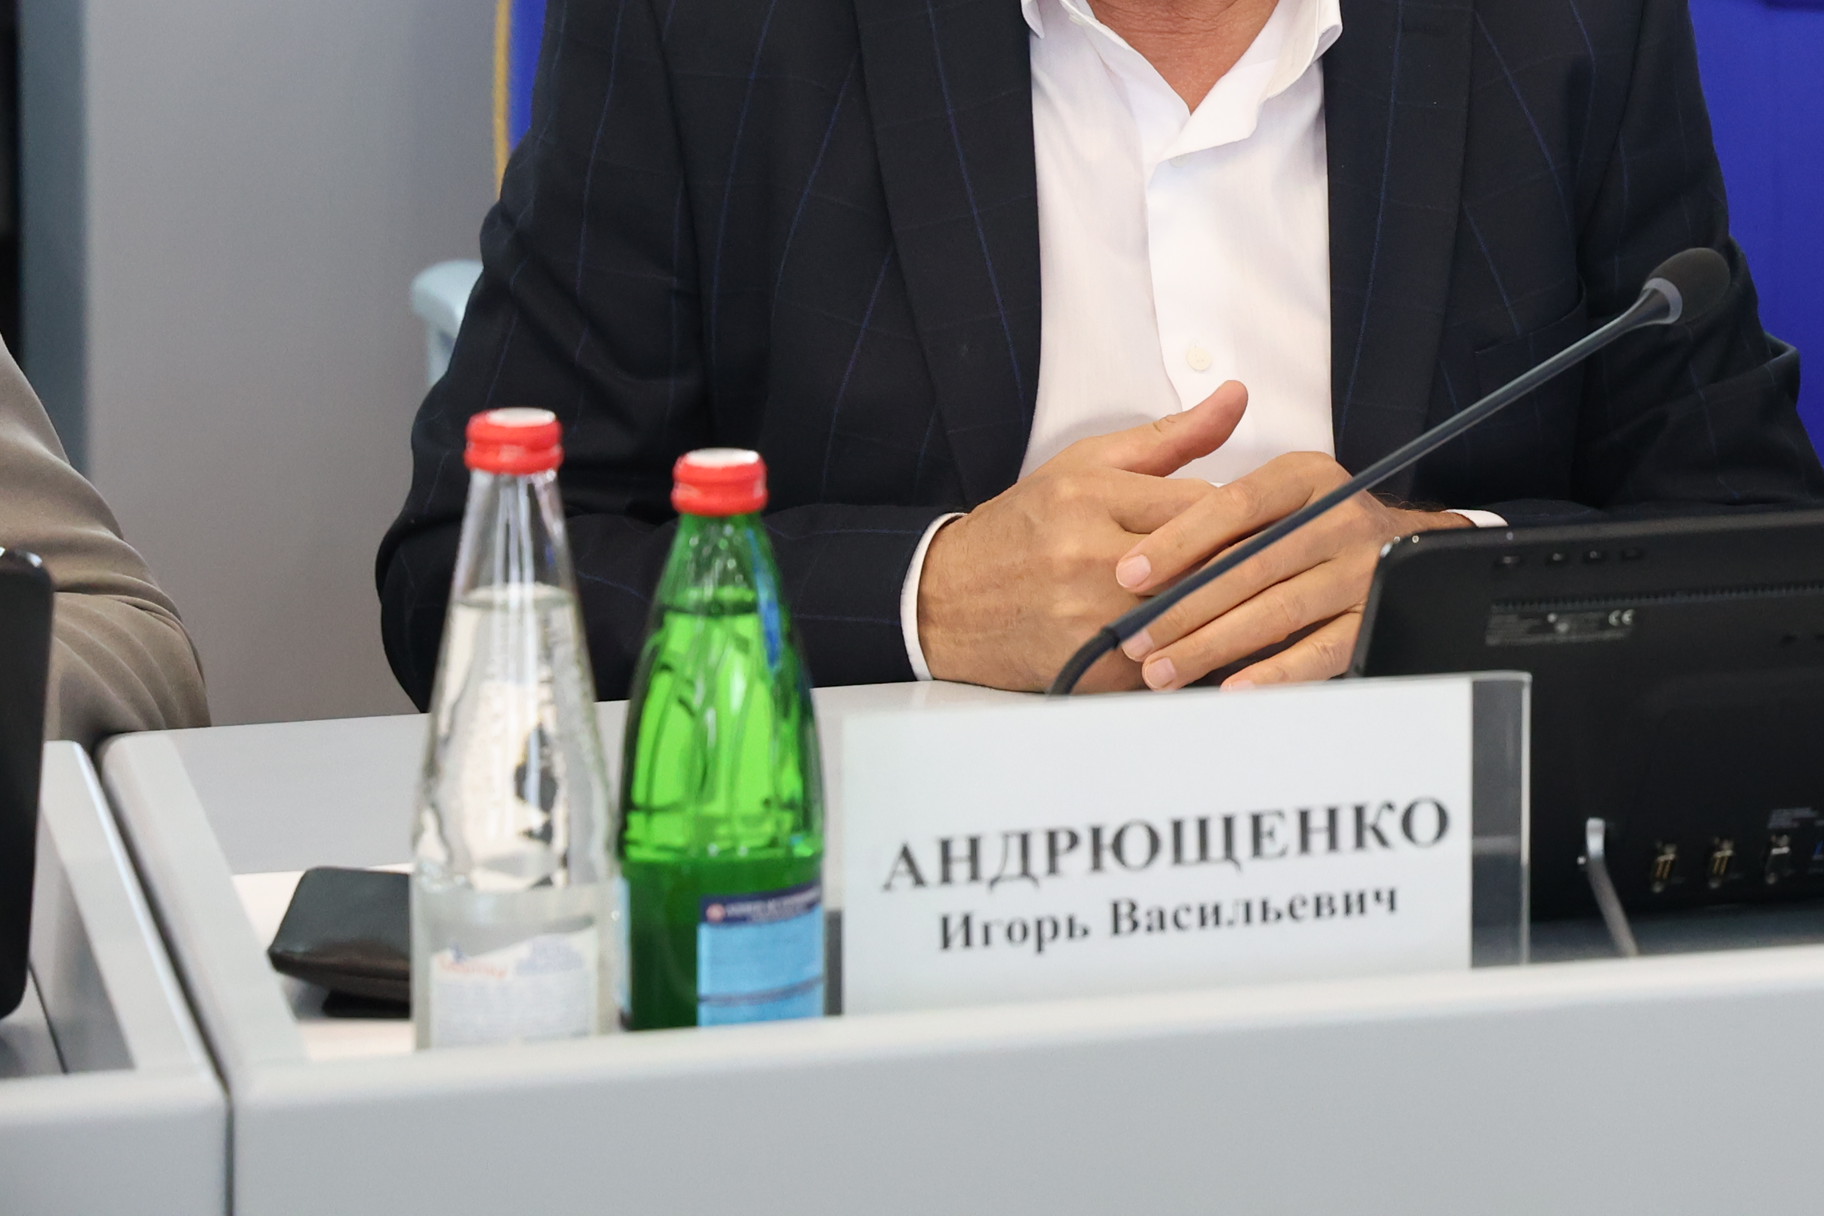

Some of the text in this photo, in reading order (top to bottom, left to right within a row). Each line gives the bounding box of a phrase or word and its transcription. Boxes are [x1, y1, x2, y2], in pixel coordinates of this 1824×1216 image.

[881, 796, 1451, 892] АНДРЮЩЕНКО
[939, 886, 1399, 955] Игорь Васильевич
